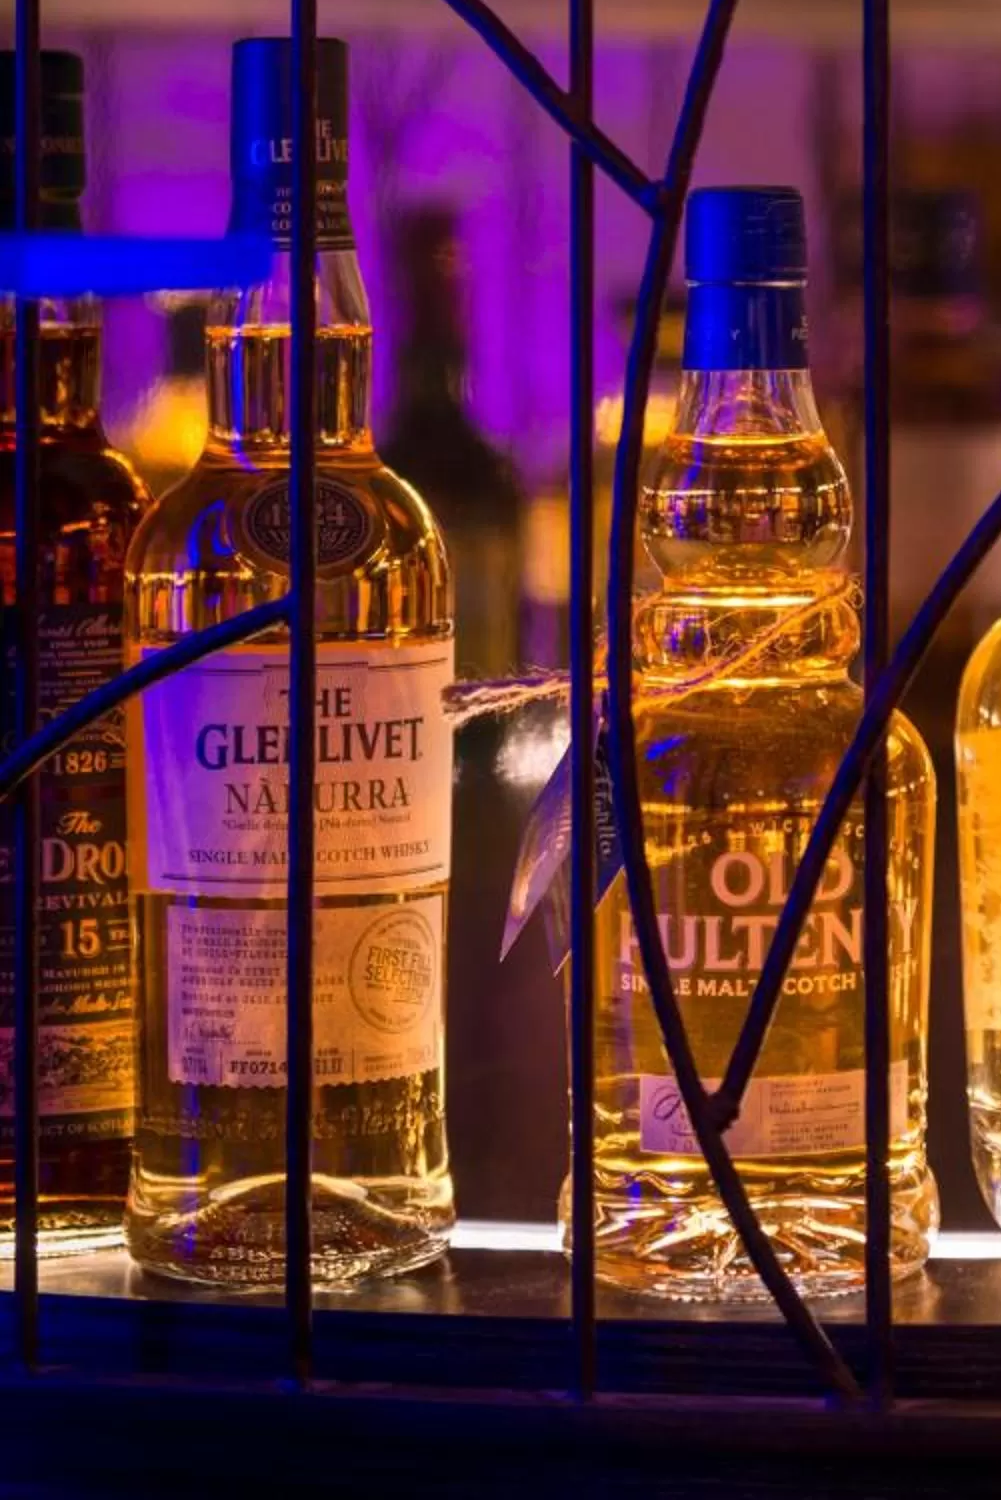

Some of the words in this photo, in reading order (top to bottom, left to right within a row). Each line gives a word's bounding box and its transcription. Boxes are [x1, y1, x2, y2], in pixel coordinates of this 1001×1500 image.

[269, 500, 346, 527] 124
[195, 716, 425, 771] GLELIVET
[53, 751, 108, 777] 1826
[223, 776, 410, 816] NÀURRA
[56, 812, 102, 837] The
[189, 847, 248, 866] SINGLE
[316, 847, 376, 865] COTCH
[380, 839, 430, 860] WHISKY
[711, 851, 855, 908] OLD
[60, 918, 101, 958] 15
[620, 974, 692, 997] SINE
[781, 973, 857, 996] COTCH
